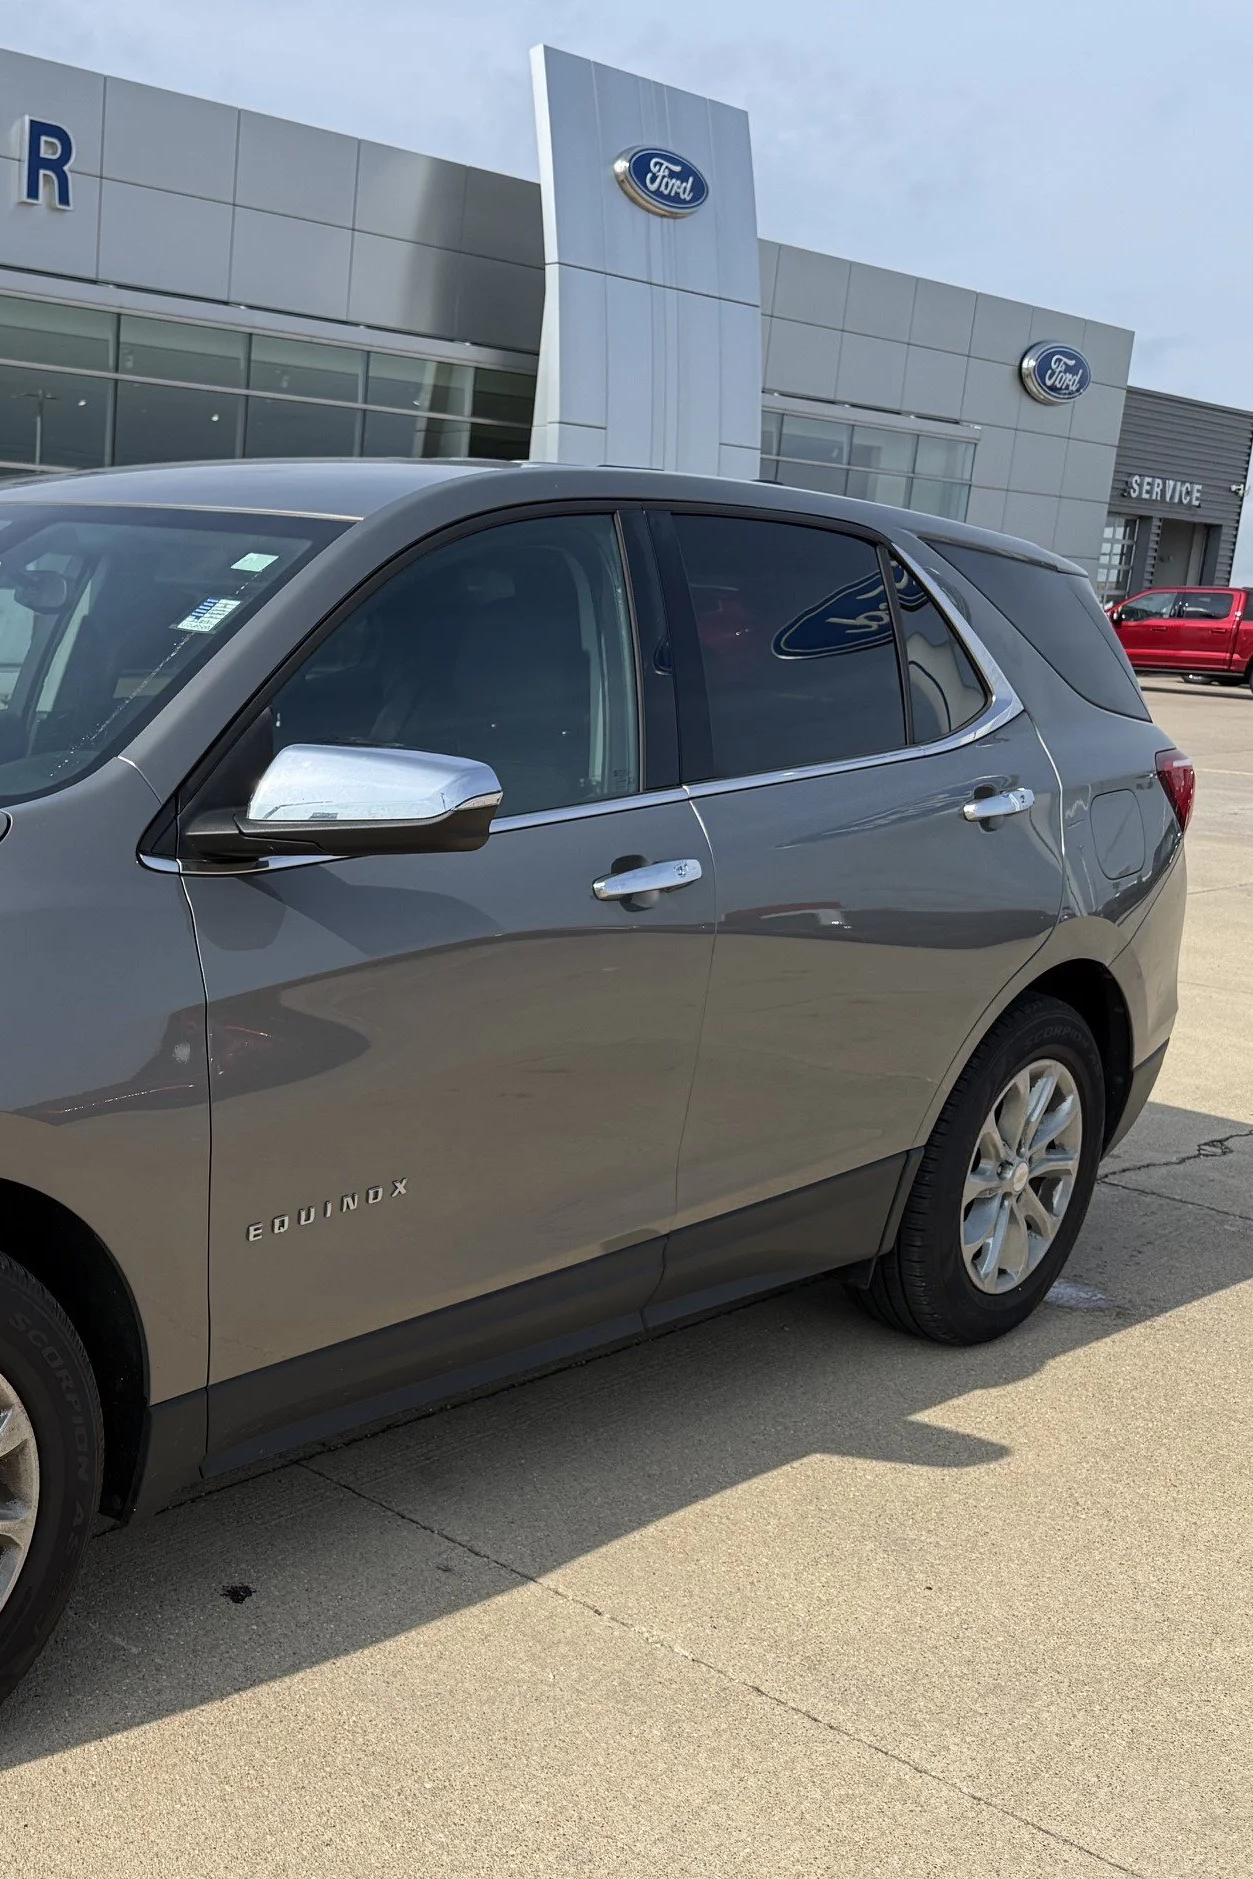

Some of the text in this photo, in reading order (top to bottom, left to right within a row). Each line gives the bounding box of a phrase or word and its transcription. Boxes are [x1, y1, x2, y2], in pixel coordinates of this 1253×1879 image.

[645, 157, 695, 202] Ford
[1045, 353, 1084, 393] Ford
[1130, 474, 1204, 507] SERVICE
[247, 1177, 409, 1242] EQUINOX
[7, 1312, 91, 1483] SCORPION
